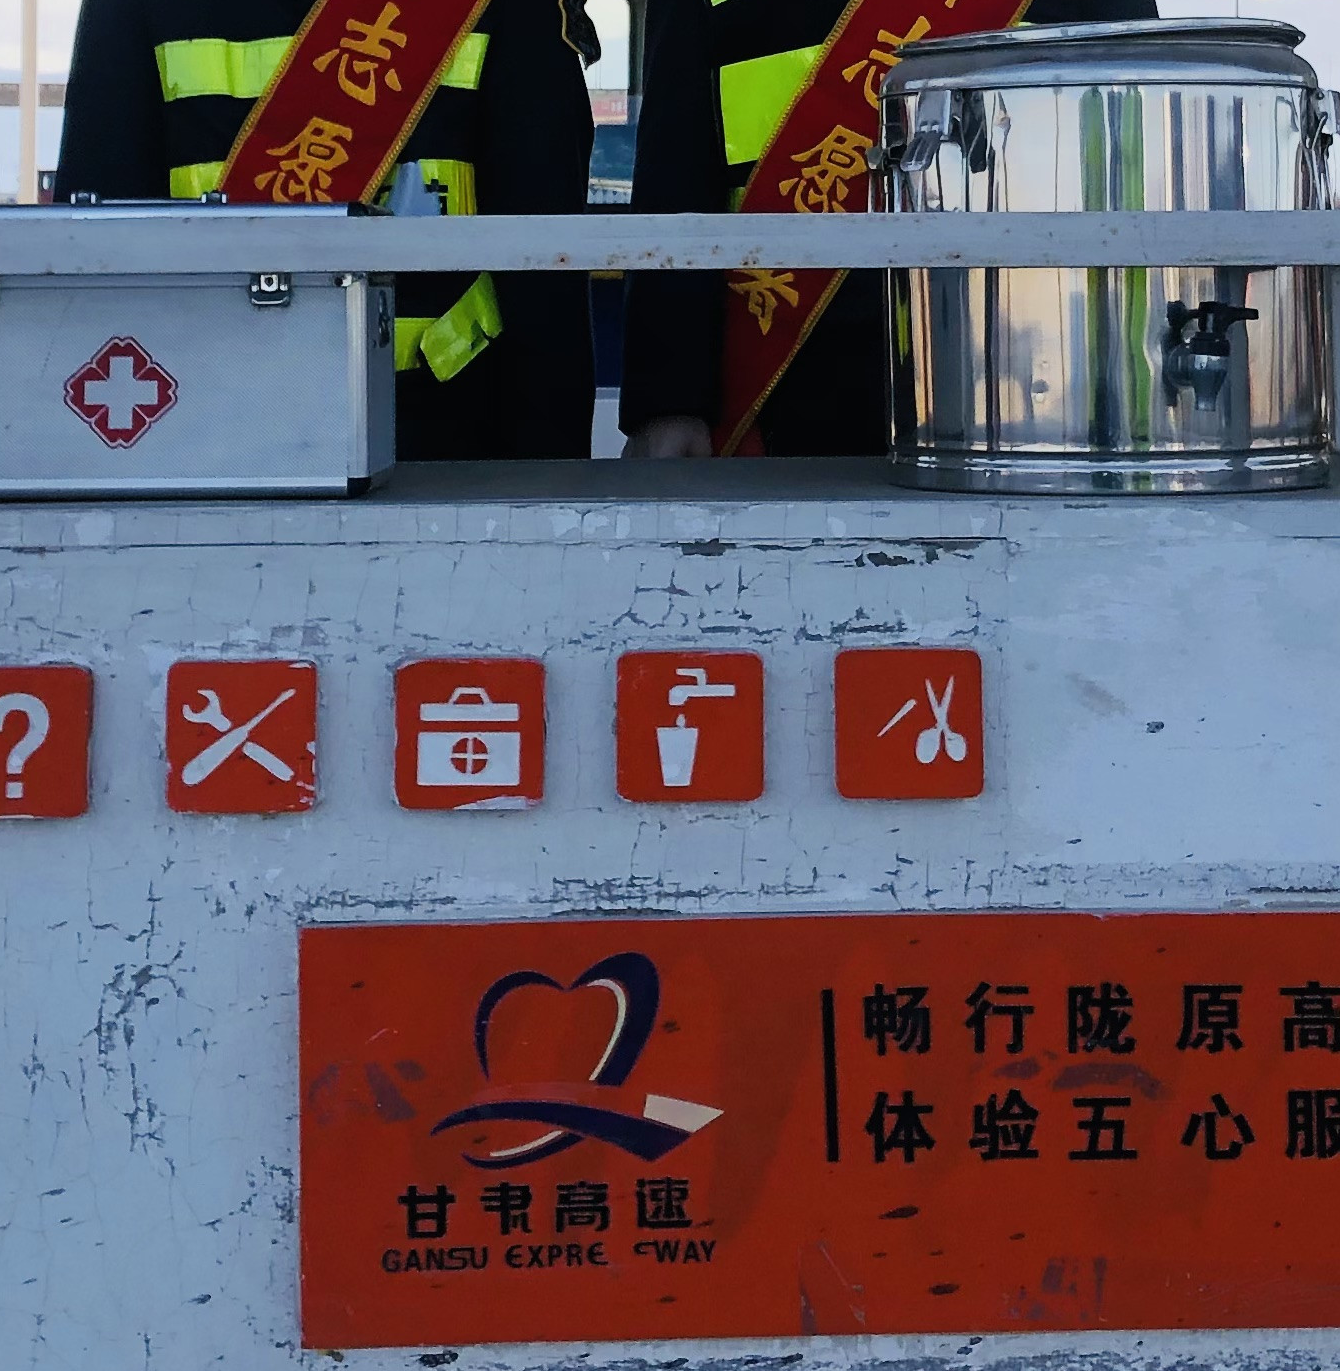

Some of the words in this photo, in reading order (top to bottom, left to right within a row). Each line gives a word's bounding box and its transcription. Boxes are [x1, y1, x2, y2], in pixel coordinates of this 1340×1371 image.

[397, 1175, 695, 1240] 甘肃高速
[381, 1246, 490, 1273] GANSU
